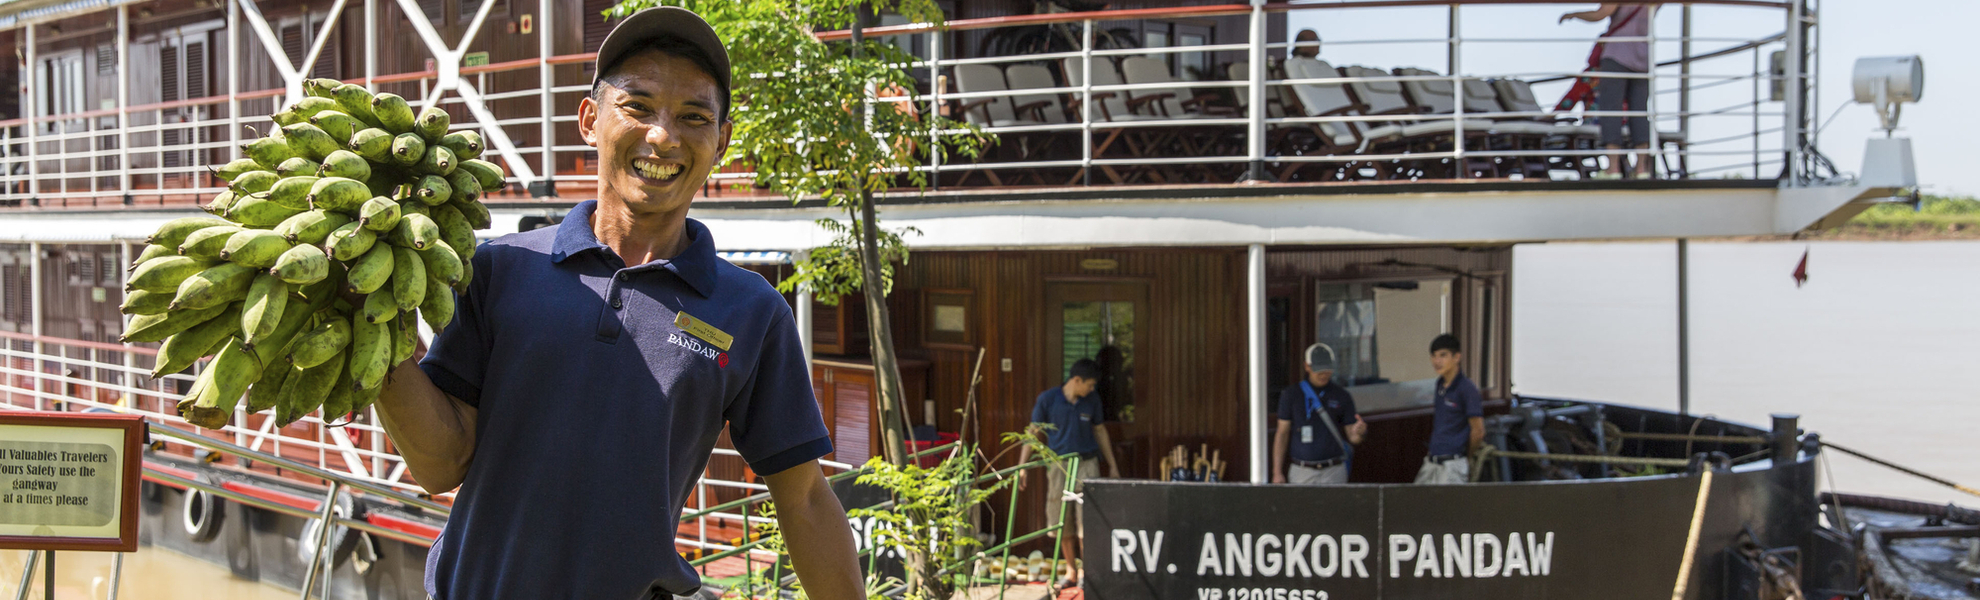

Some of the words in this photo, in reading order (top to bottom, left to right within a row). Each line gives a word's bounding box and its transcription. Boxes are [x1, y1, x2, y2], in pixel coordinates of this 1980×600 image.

[667, 333, 719, 360] PANDAW
[9, 449, 58, 461] Valuables
[60, 450, 108, 463] Travelers
[26, 464, 57, 477] Safety
[59, 466, 77, 477] use
[79, 466, 96, 477] the
[12, 479, 58, 491] gangway
[3, 493, 13, 504] at
[16, 494, 23, 504] a
[26, 493, 53, 505] times
[56, 494, 88, 506] please
[1111, 528, 1177, 574] RV.
[1197, 531, 1370, 578] ANGKOR
[1388, 531, 1555, 578] PANDAW
